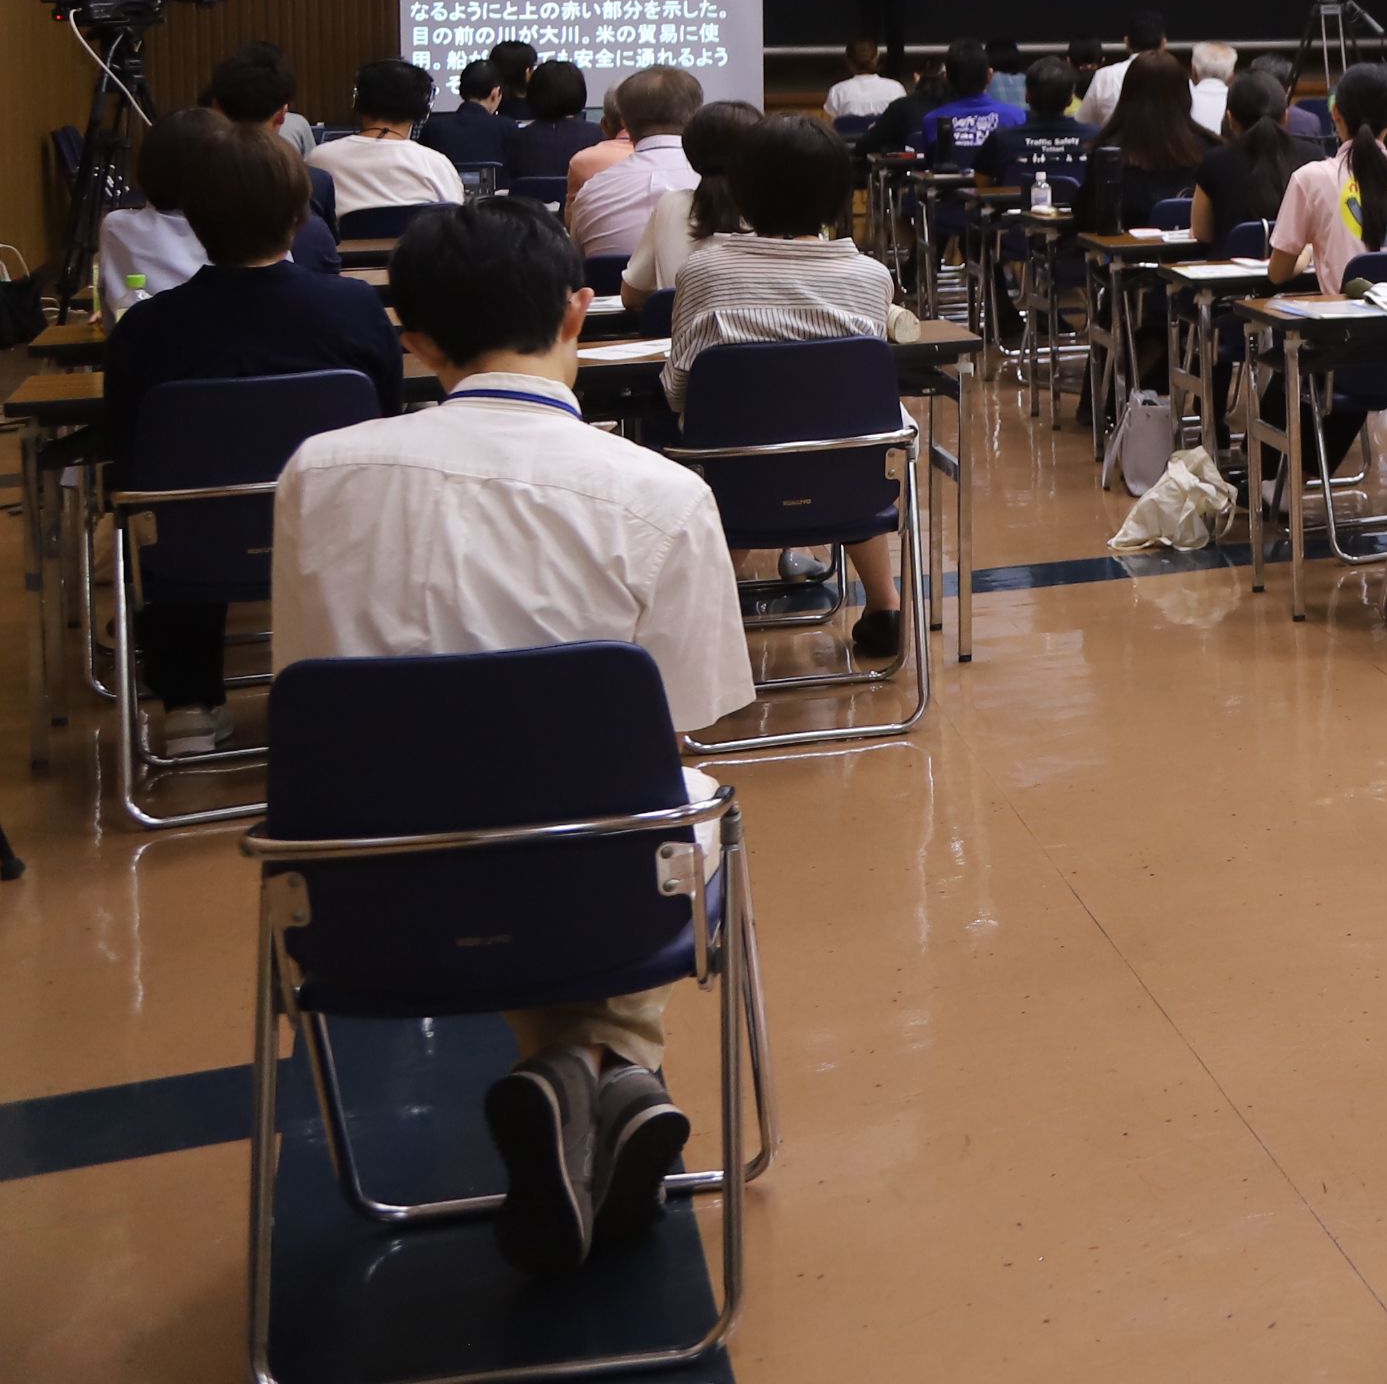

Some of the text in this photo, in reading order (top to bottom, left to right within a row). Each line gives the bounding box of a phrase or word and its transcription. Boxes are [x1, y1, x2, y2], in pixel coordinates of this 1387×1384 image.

[410, 0, 727, 21] なるようにと上の赤い部分を示した。
[412, 23, 720, 46] 目の前の川が大川。米の貿易に使
[1025, 137, 1079, 146] Traffic Safety
